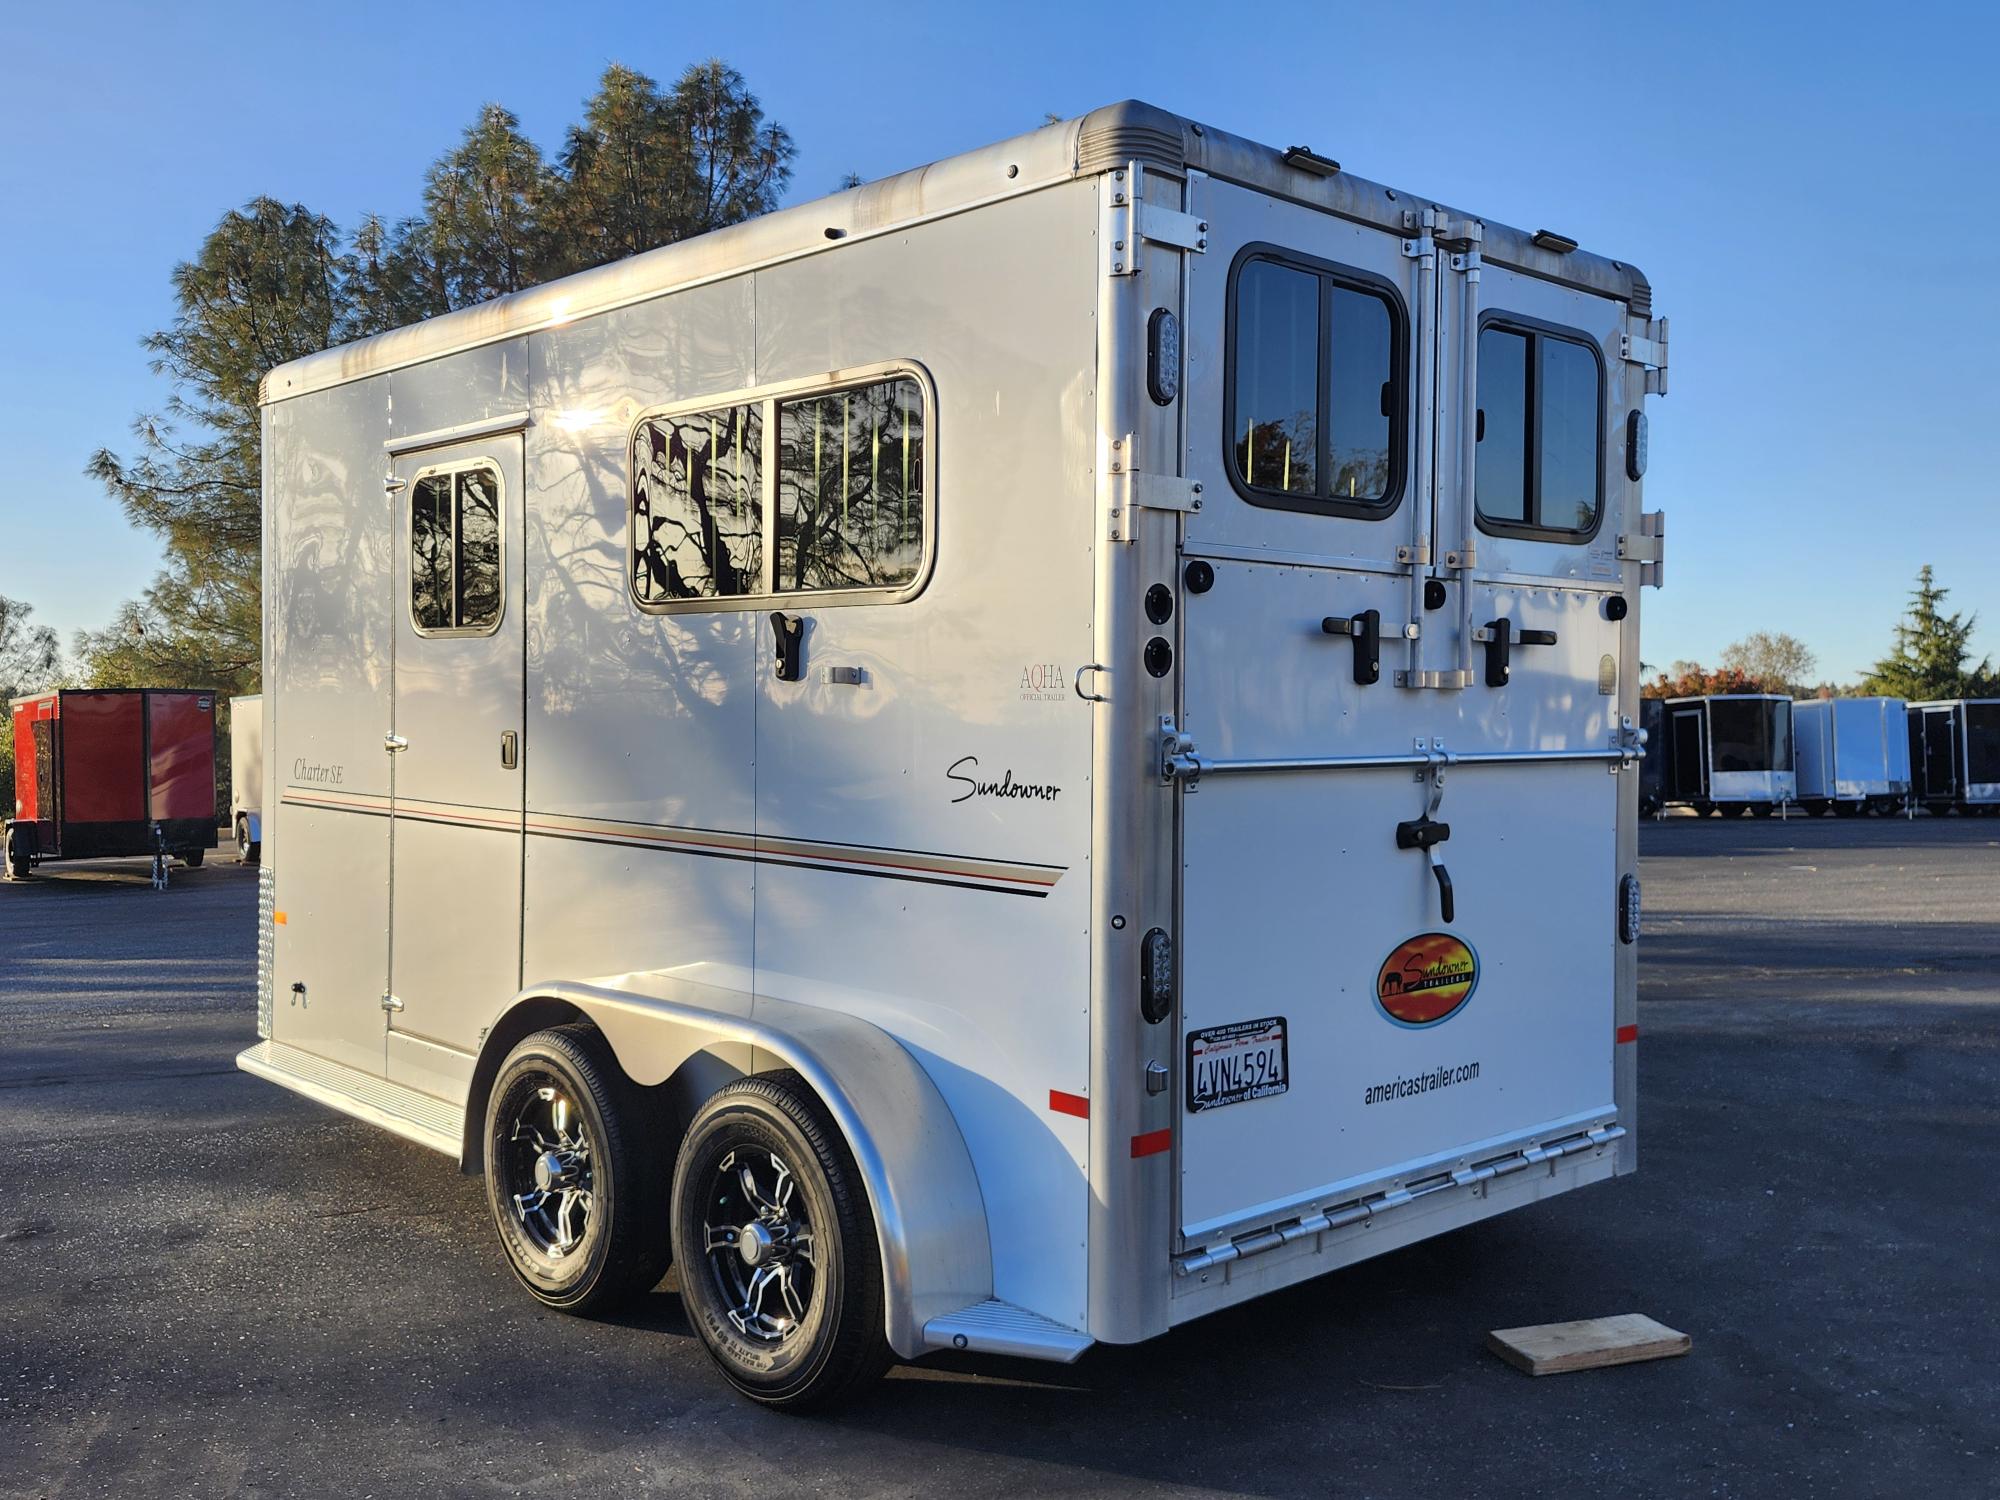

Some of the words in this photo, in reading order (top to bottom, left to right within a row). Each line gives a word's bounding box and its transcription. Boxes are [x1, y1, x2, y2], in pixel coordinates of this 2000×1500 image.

[1020, 664, 1065, 693] AQHA
[946, 755, 1061, 804] Sundowner
[1404, 953, 1469, 989] Sundowner
[1424, 975, 1465, 988] TRAILERS
[1200, 1030, 1216, 1039] OVER
[1227, 1023, 1252, 1033] TRAILERS
[1259, 1019, 1277, 1028] STOCK
[1197, 1047, 1279, 1095] 4VN4594
[1365, 1061, 1480, 1105] americastrailer.com
[1194, 1092, 1243, 1113] Sundowner
[1243, 1088, 1251, 1100] of
[1252, 1082, 1286, 1097] California
